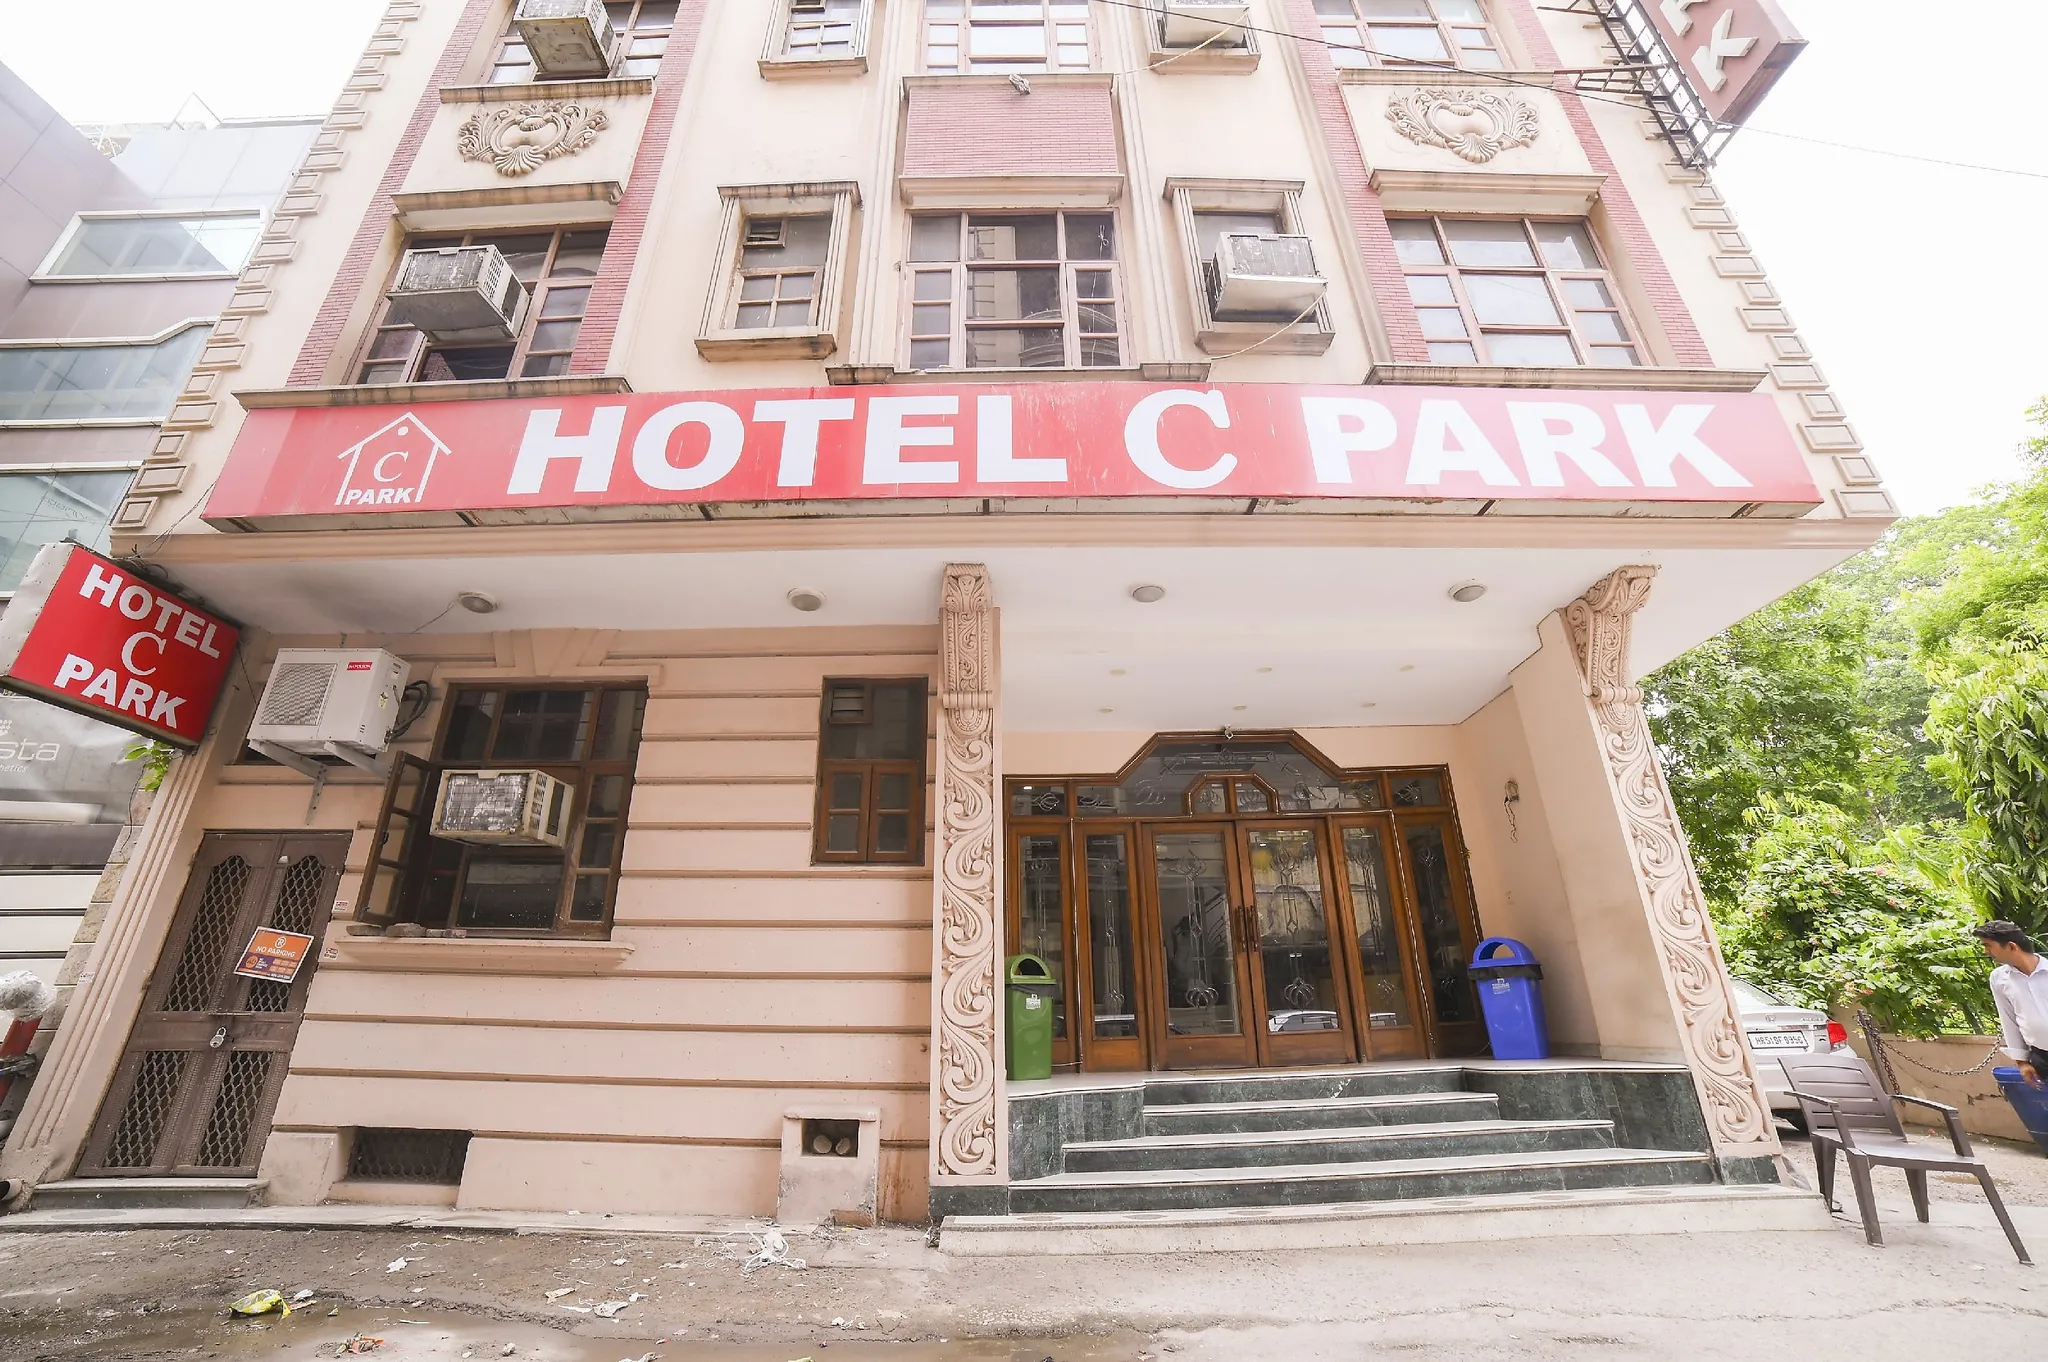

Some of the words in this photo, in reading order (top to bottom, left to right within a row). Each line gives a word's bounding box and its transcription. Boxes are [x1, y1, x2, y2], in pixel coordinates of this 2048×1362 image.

[507, 392, 1068, 494] HOTEL
[1125, 390, 1238, 489] C
[1301, 397, 1753, 487] PARK
[374, 451, 408, 482] C
[344, 488, 415, 505] PARK
[79, 563, 221, 659] HOTEL
[121, 631, 167, 676] C
[53, 653, 187, 729] PARK
[267, 948, 296, 957] PARKING
